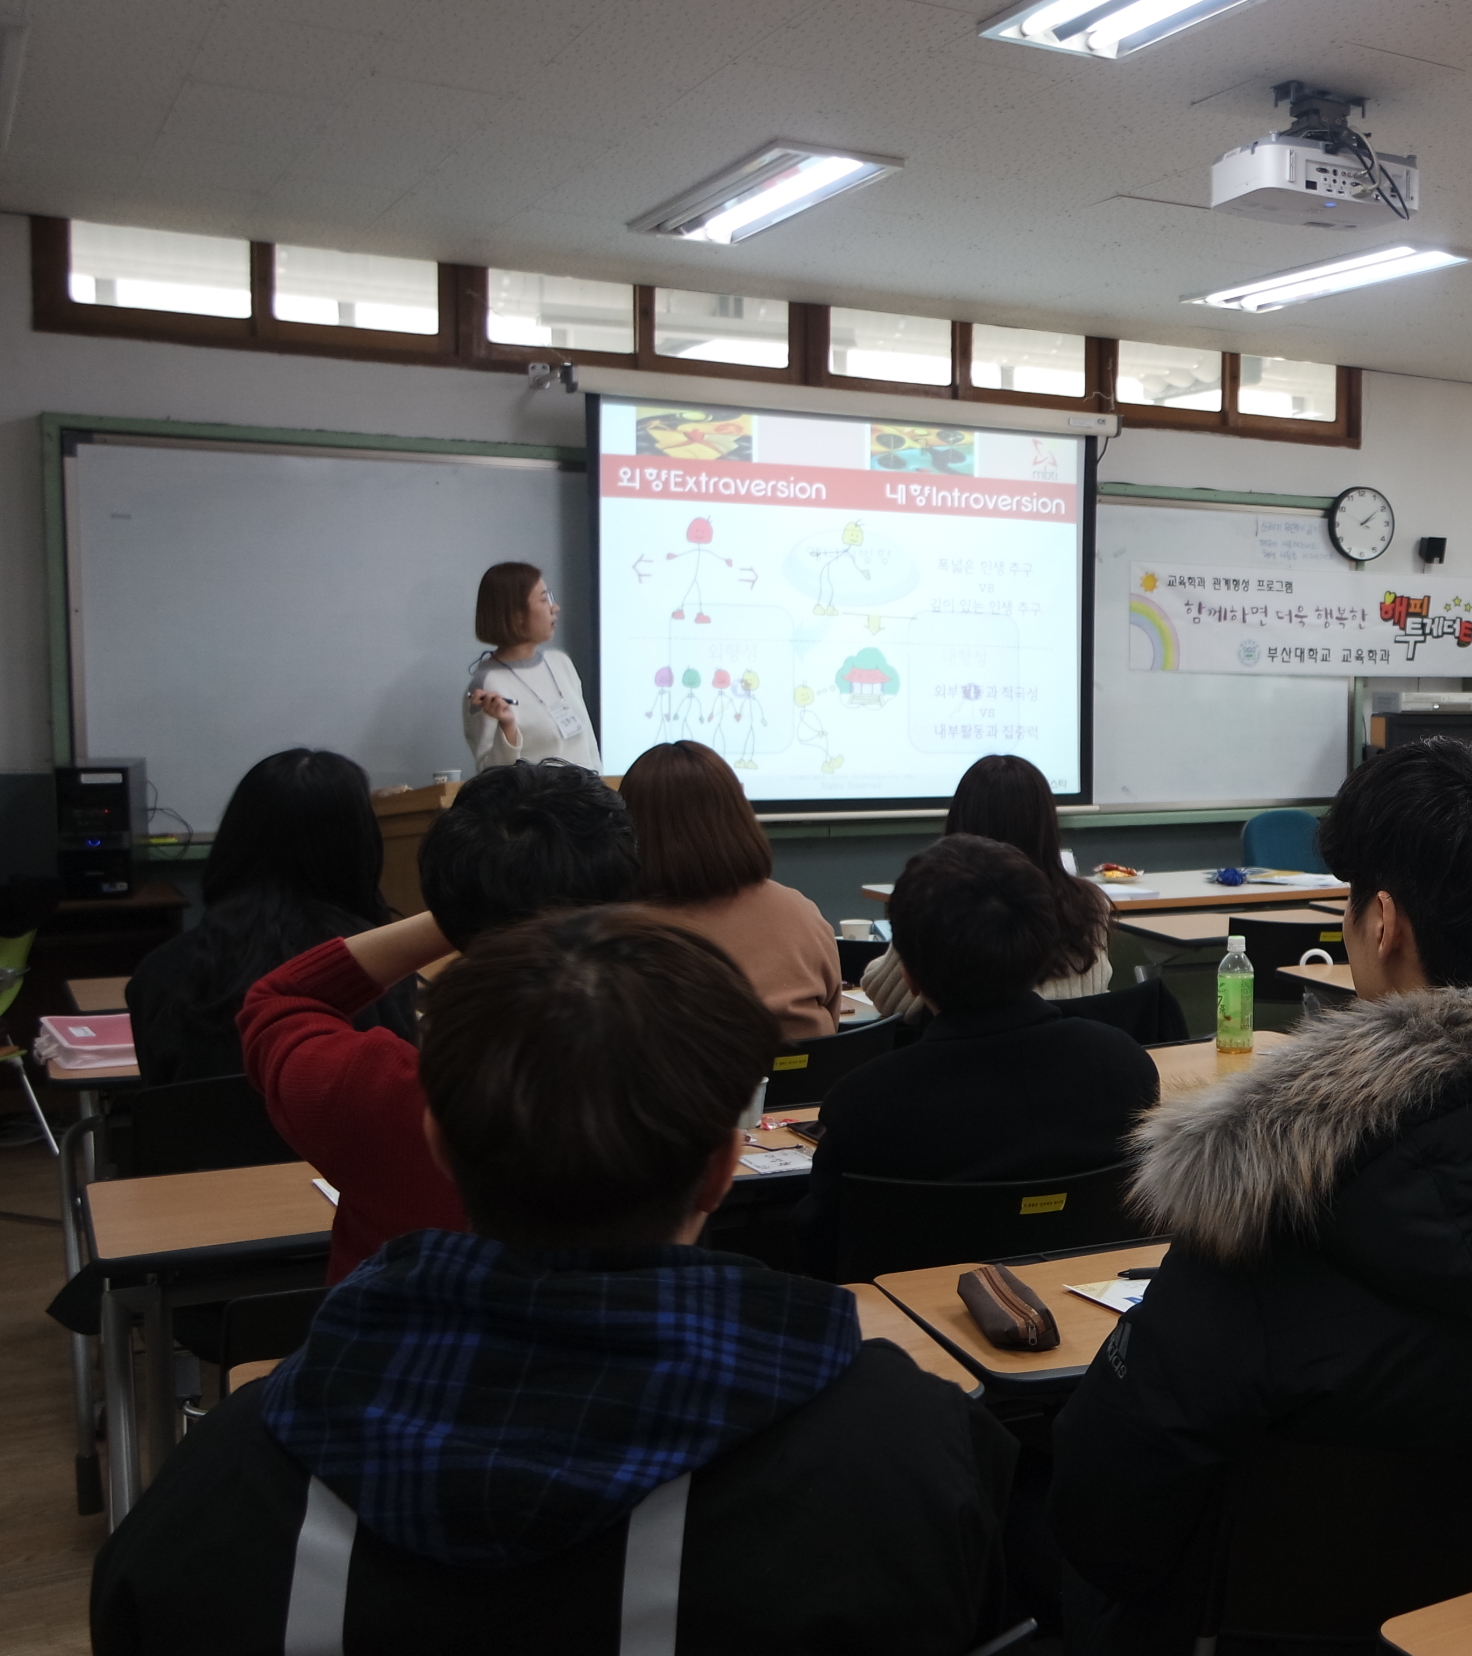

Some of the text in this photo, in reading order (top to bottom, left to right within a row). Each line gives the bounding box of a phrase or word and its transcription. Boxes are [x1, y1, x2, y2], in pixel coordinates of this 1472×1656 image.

[1033, 468, 1059, 481] mbti
[618, 467, 1066, 514] 외향Extraversion 내향Introversion
[938, 558, 1034, 578] 폭넓은 인생 추구
[1167, 574, 1294, 594] 교육학과 관계형성 프로그램
[930, 597, 1042, 617] 깊이 있는 인생 추구
[1184, 599, 1368, 630] 함께하면 더욱 행복한
[1379, 591, 1431, 631] 해피
[707, 643, 758, 663] 외향성
[942, 648, 987, 668] 내향성
[1267, 646, 1391, 665] 부산대학교 교육학과
[1002, 685, 1039, 702] 적극성
[934, 723, 1039, 741] 내부활동과 집중력
